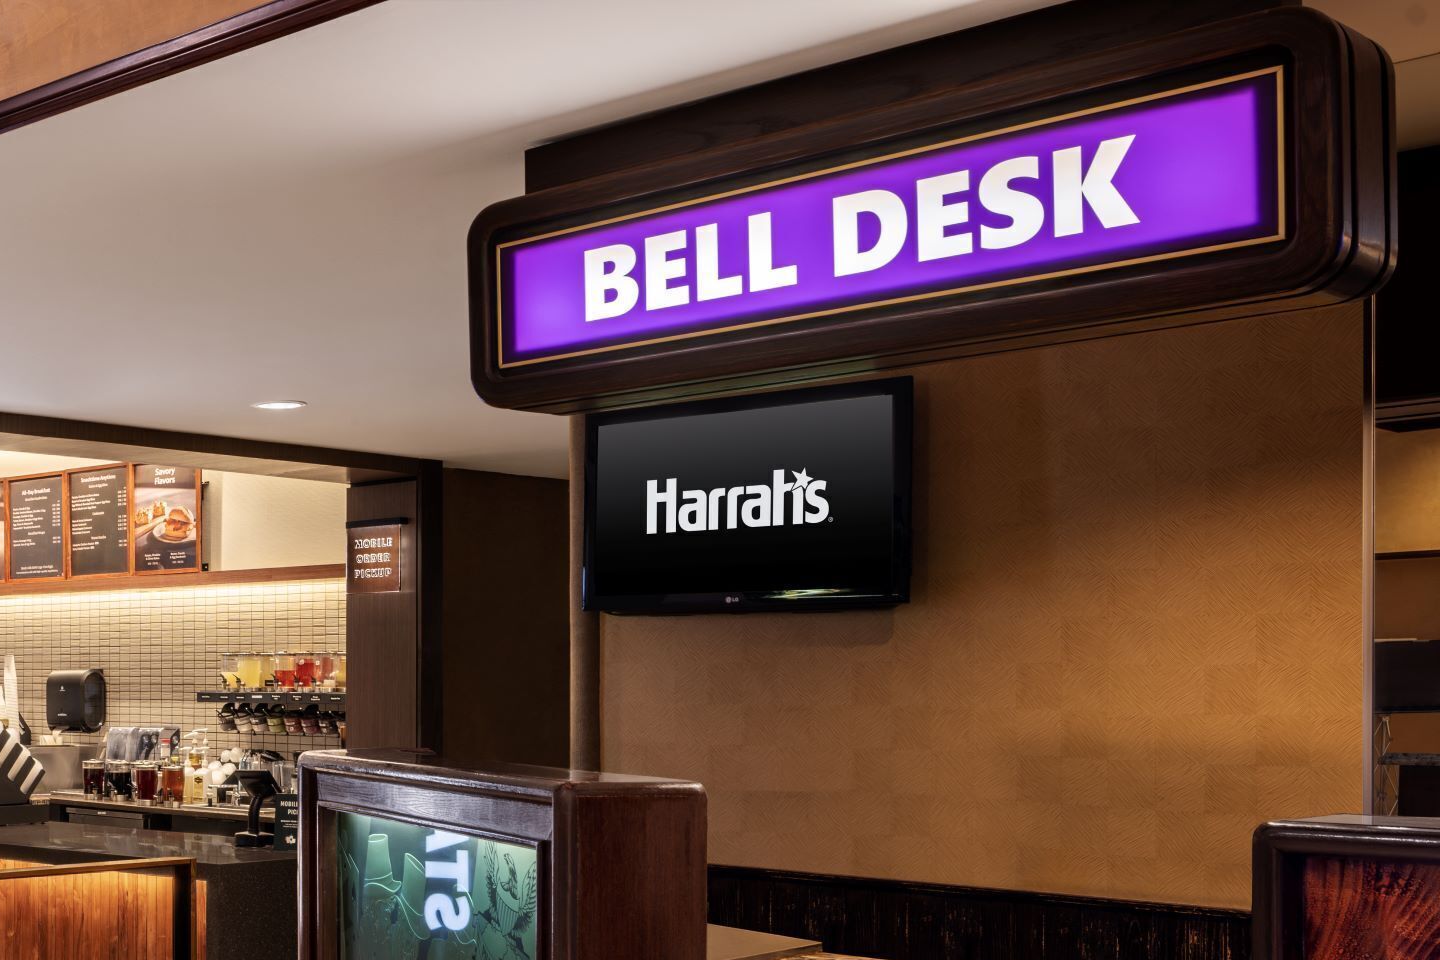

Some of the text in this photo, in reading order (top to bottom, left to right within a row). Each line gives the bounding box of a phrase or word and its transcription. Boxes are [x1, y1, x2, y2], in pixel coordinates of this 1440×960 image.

[584, 134, 1141, 323] BELL DESK
[154, 467, 176, 477] Savory
[154, 477, 176, 485] Flavors
[354, 537, 393, 549] MOBILE
[356, 552, 391, 564] ORDER
[354, 567, 393, 579] PICKUP
